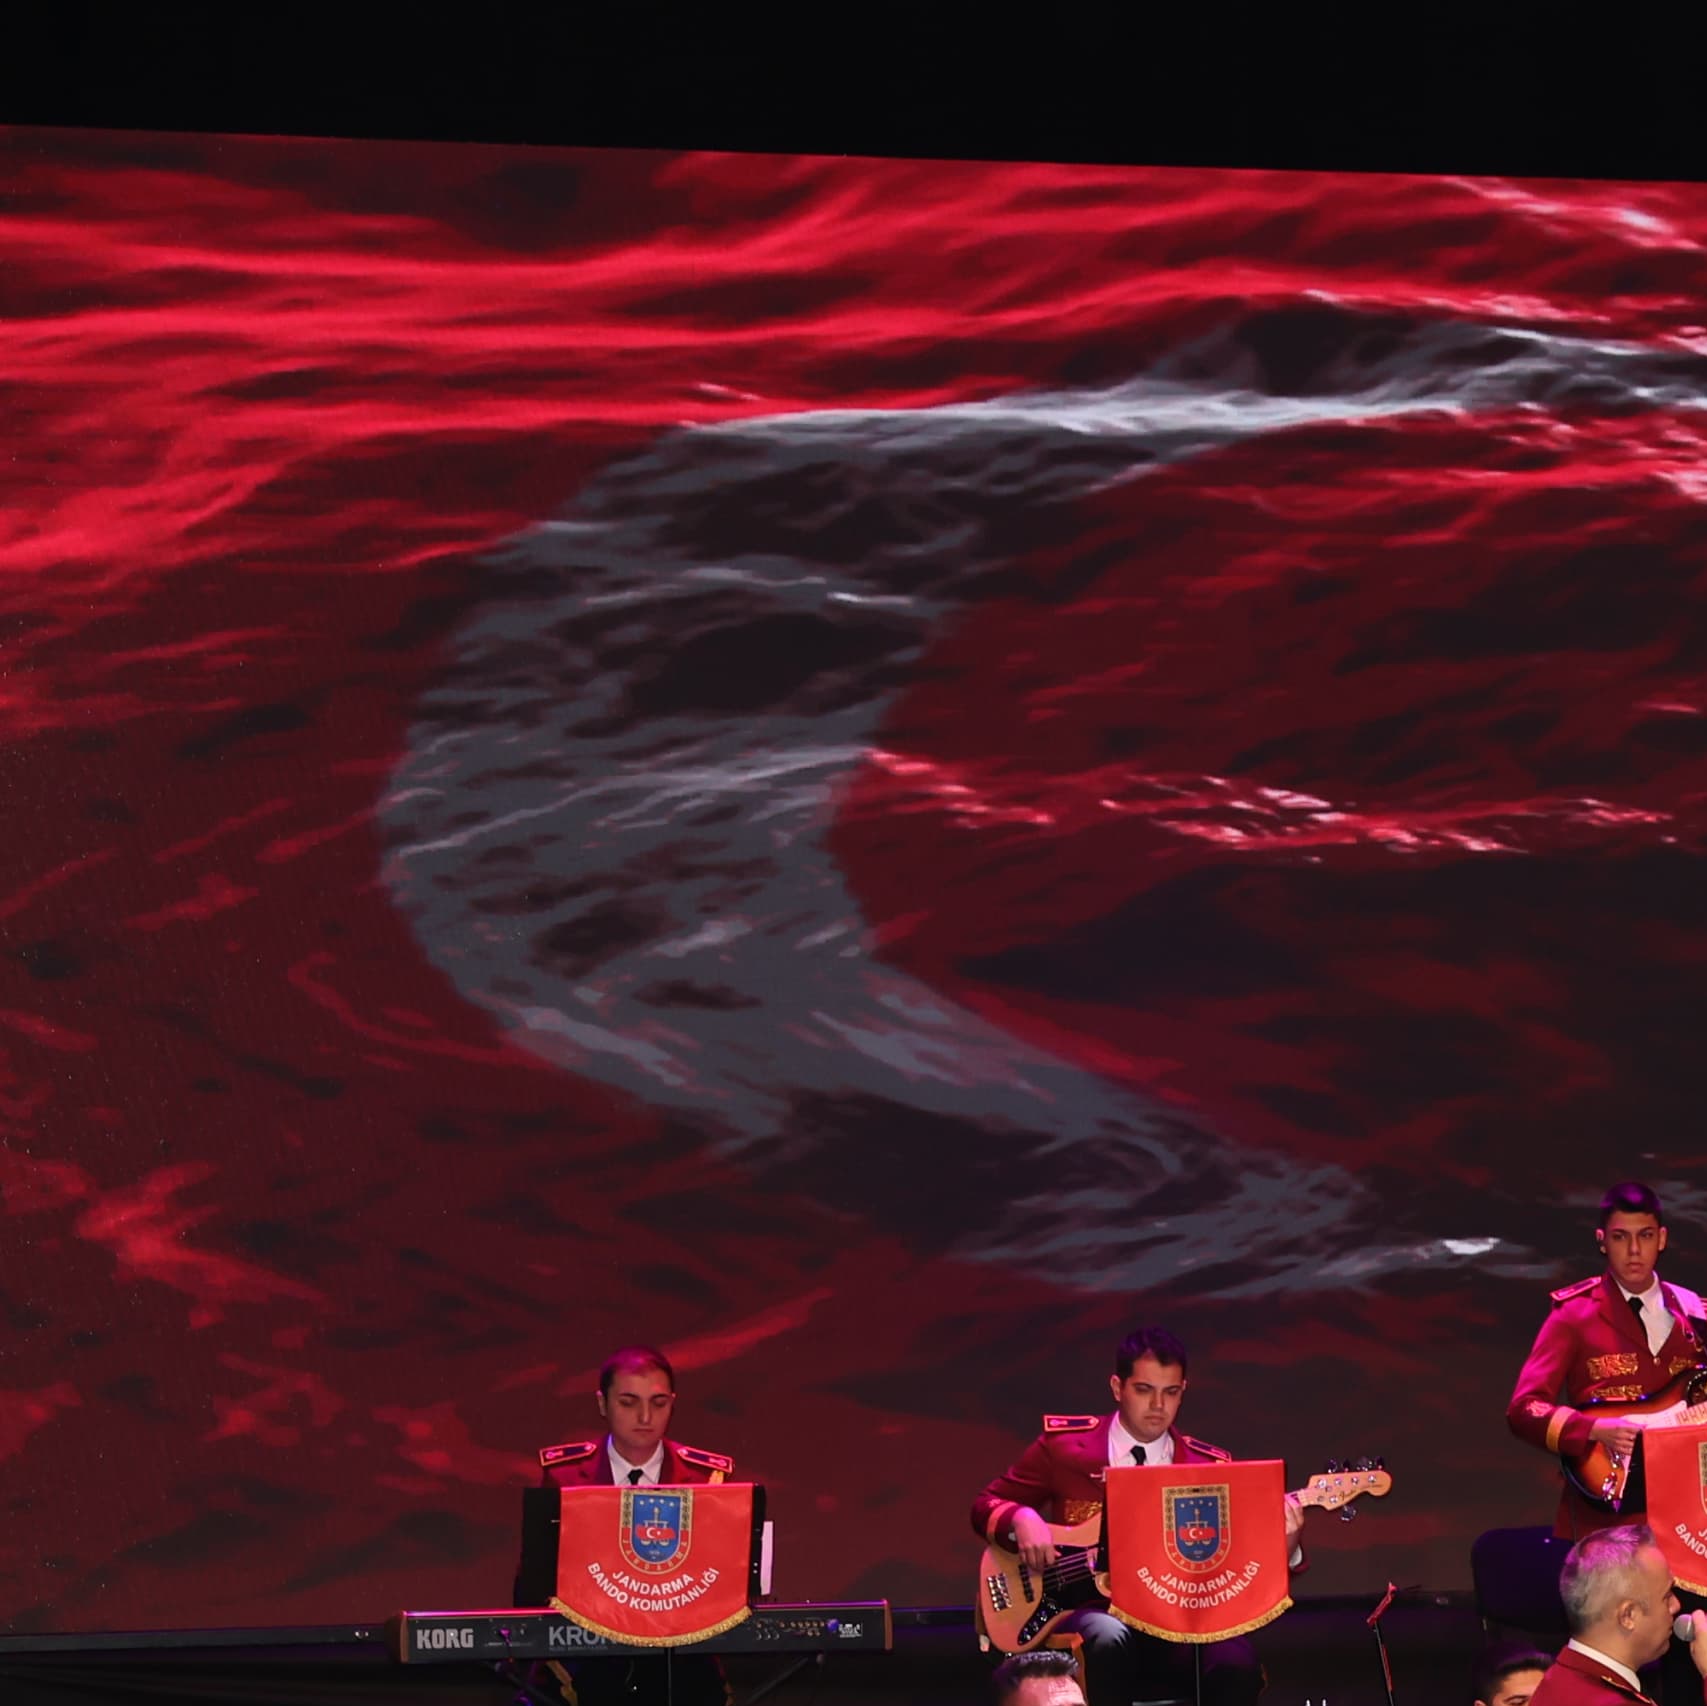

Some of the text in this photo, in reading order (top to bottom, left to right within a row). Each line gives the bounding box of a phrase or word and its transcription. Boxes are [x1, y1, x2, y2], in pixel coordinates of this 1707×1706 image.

[587, 1562, 720, 1612] BANDO KOMUTANLIĞI
[612, 1571, 695, 1596] JANDARMA
[1136, 1560, 1261, 1609] BANDO KOMUTANLIĞI
[1160, 1569, 1237, 1594] JANDARMA
[416, 1628, 474, 1650] KORG
